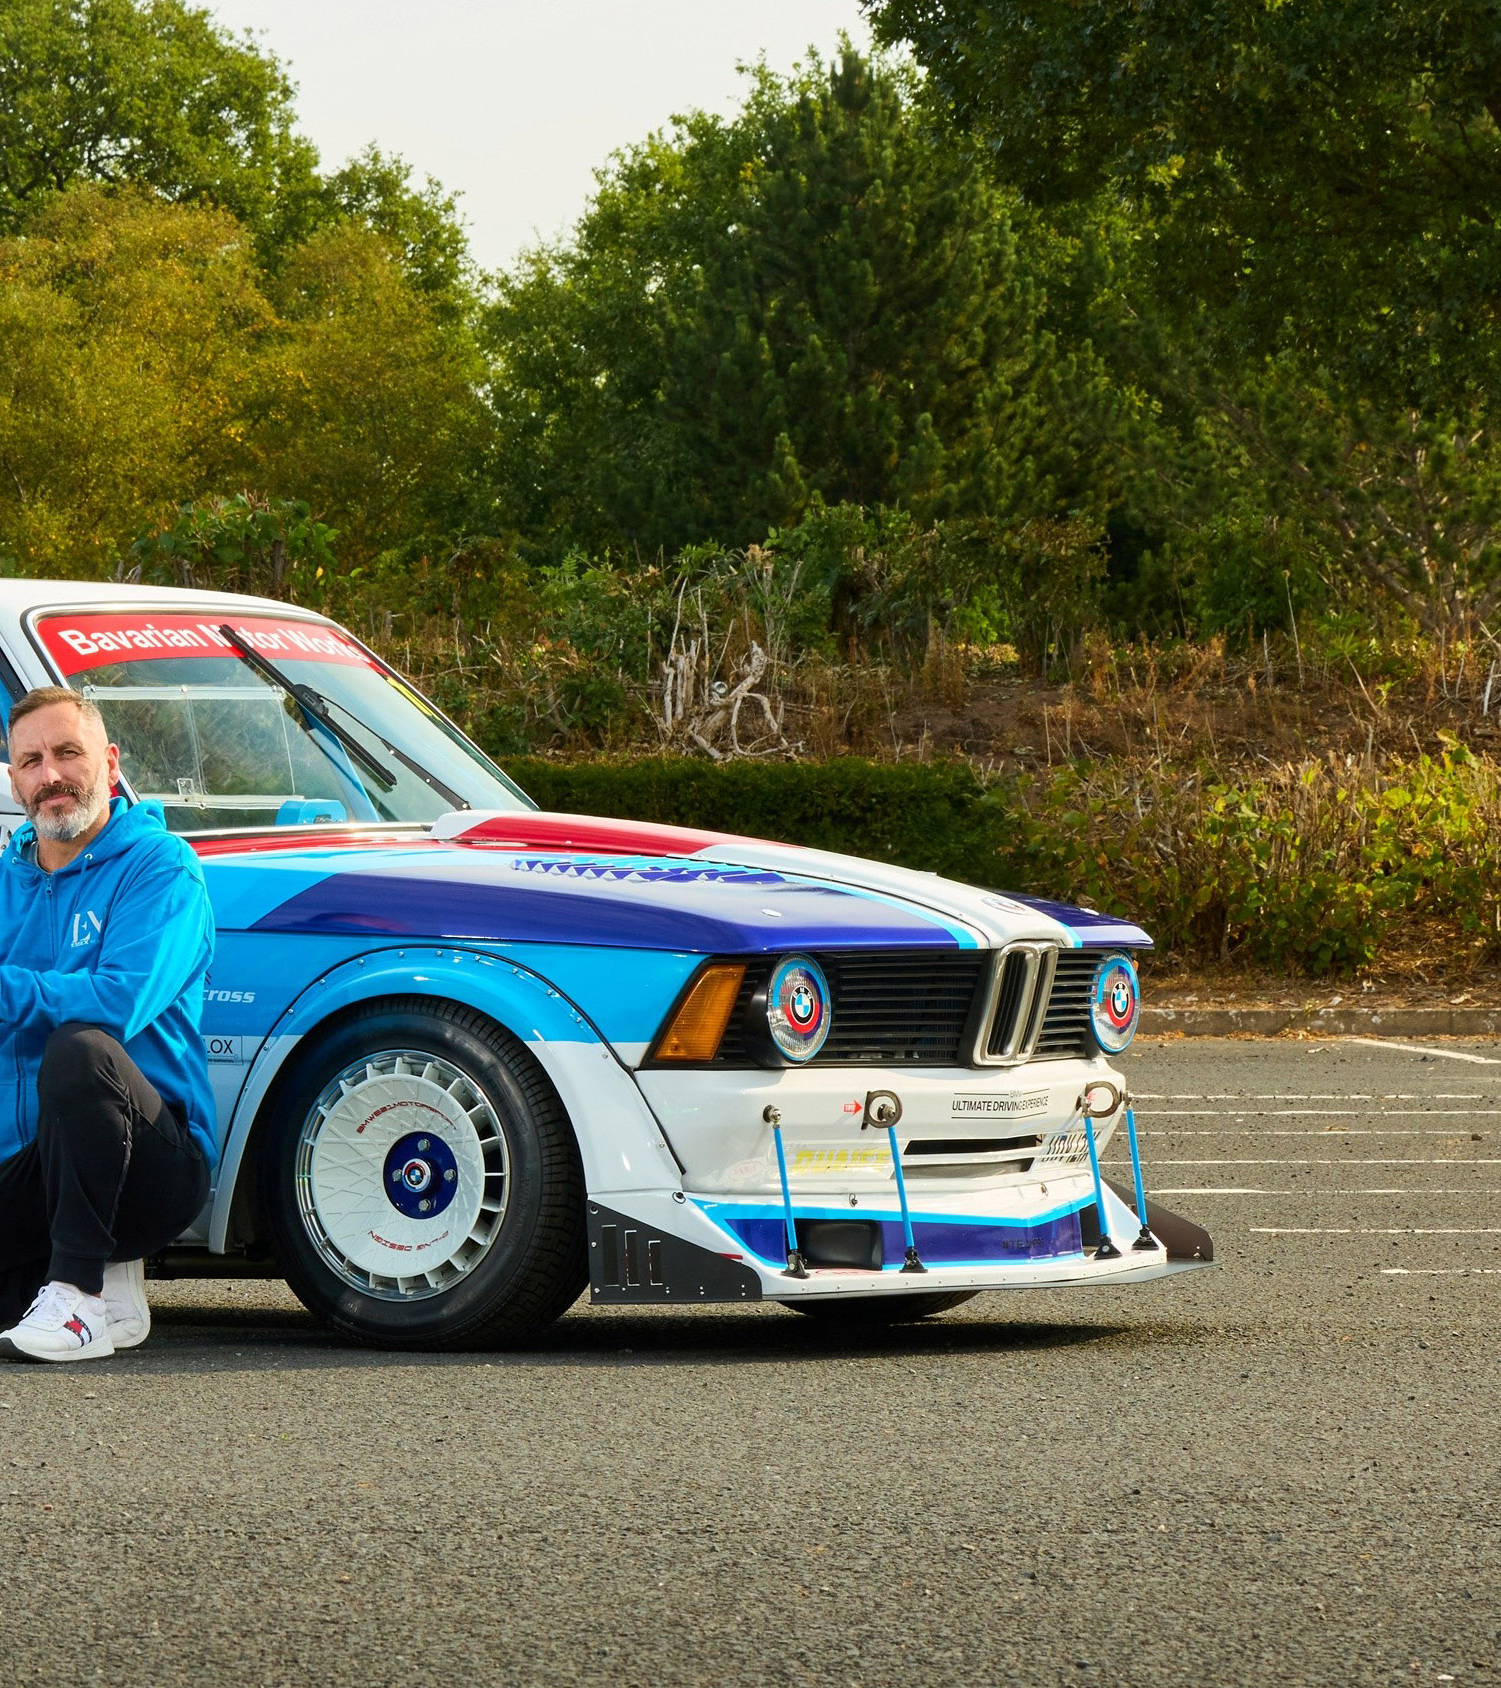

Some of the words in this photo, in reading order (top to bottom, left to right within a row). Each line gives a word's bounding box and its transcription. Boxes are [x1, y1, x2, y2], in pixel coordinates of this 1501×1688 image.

[57, 623, 199, 656] Bavarian
[952, 1100, 992, 1112] ULTIMATE
[993, 1100, 1022, 1112] DRIVING
